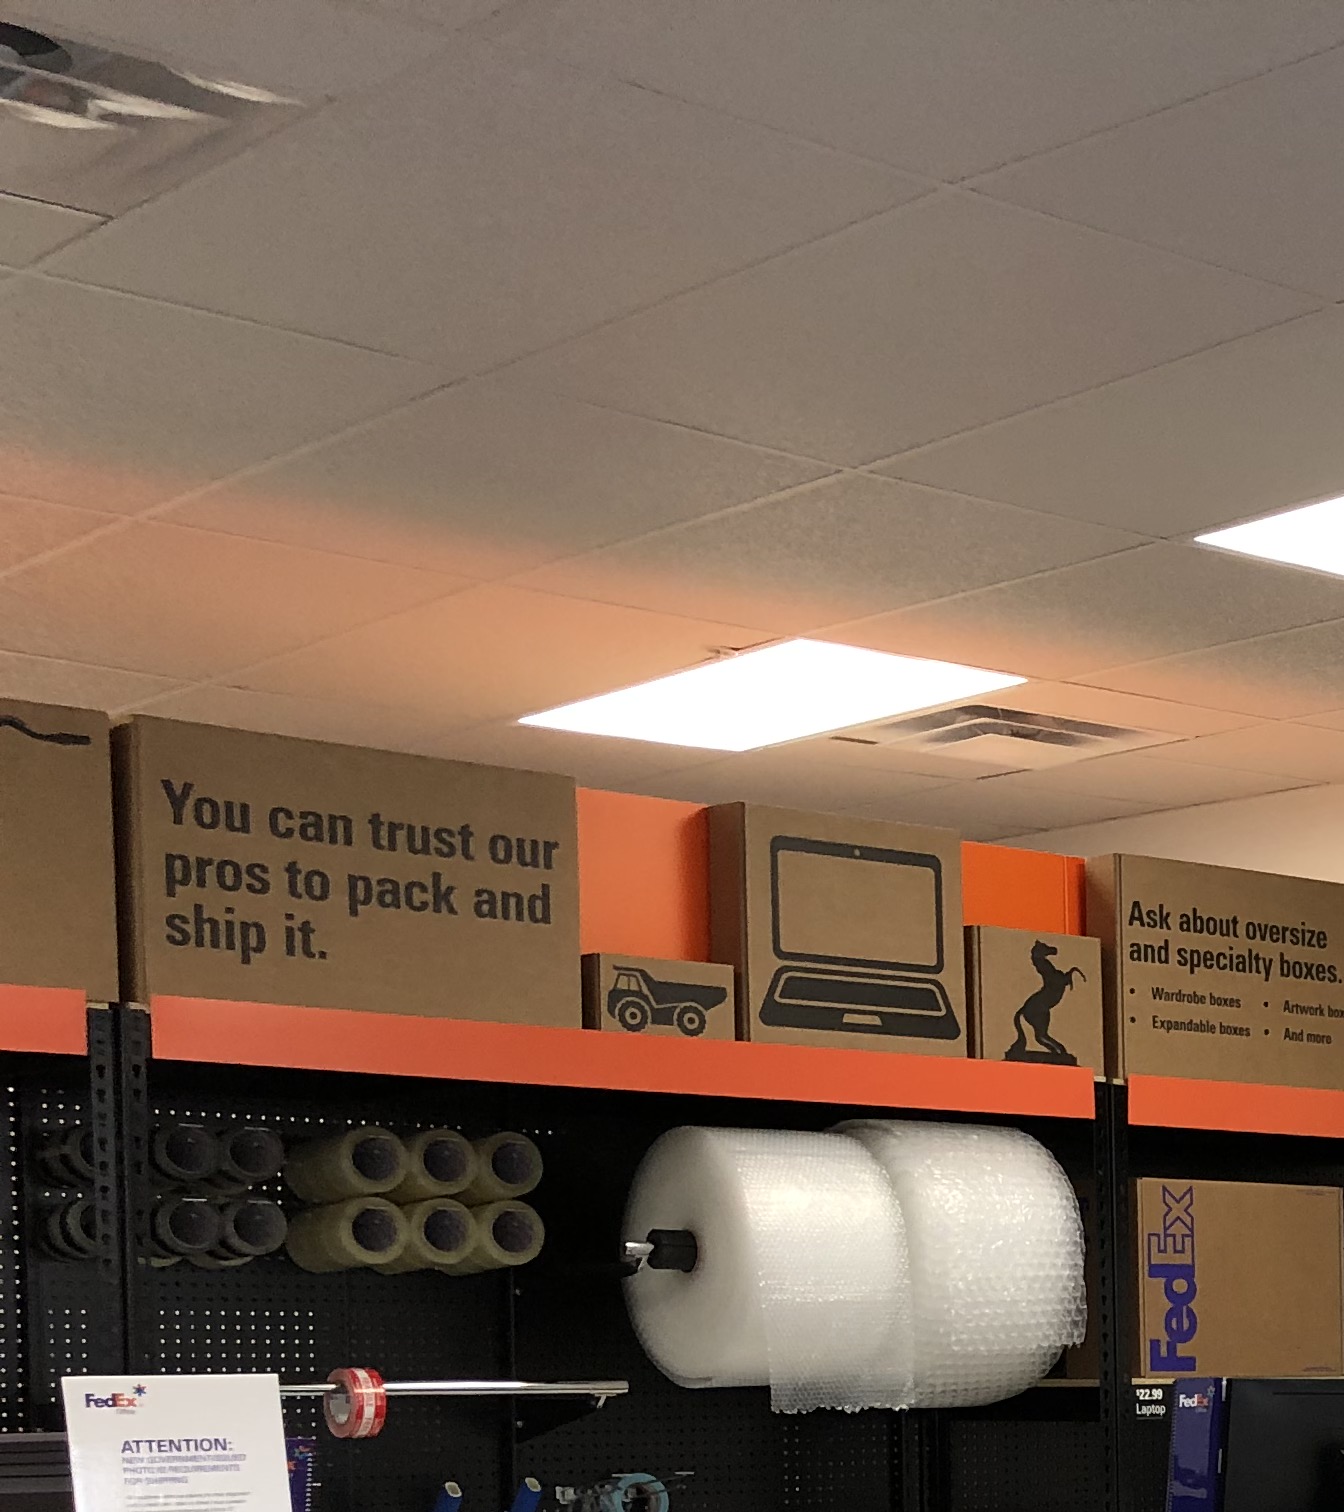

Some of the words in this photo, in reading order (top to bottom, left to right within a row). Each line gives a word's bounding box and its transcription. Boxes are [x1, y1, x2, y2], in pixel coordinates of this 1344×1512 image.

[161, 779, 251, 836] You
[268, 801, 354, 848] can
[368, 811, 474, 863] trust
[487, 831, 560, 872] our
[164, 851, 271, 898] pros
[286, 860, 331, 902] to
[347, 871, 459, 918] pack
[473, 883, 552, 926] and
[165, 905, 266, 965] ship
[284, 912, 328, 960] it.
[1128, 900, 1172, 931] Ask
[1178, 907, 1240, 939] about
[1245, 921, 1329, 950] oversize
[1129, 938, 1170, 965] and
[1176, 946, 1274, 982] specialty
[1279, 951, 1343, 984] boxes.
[1151, 986, 1207, 1005] Wardrobe
[1209, 992, 1242, 1009] boxes
[1283, 1000, 1325, 1017] Artwork
[1152, 1015, 1216, 1034] Expandable
[1219, 1020, 1251, 1038] boxes
[1283, 1027, 1304, 1042] And
[1306, 1031, 1332, 1045] more
[1148, 1184, 1198, 1373] FedEx
[84, 1393, 137, 1408] FedEx
[1136, 1388, 1163, 1401] $22.99
[1179, 1393, 1210, 1409] FedEx
[1136, 1403, 1166, 1416] Laptop
[121, 1437, 233, 1454] ATTENTION:
